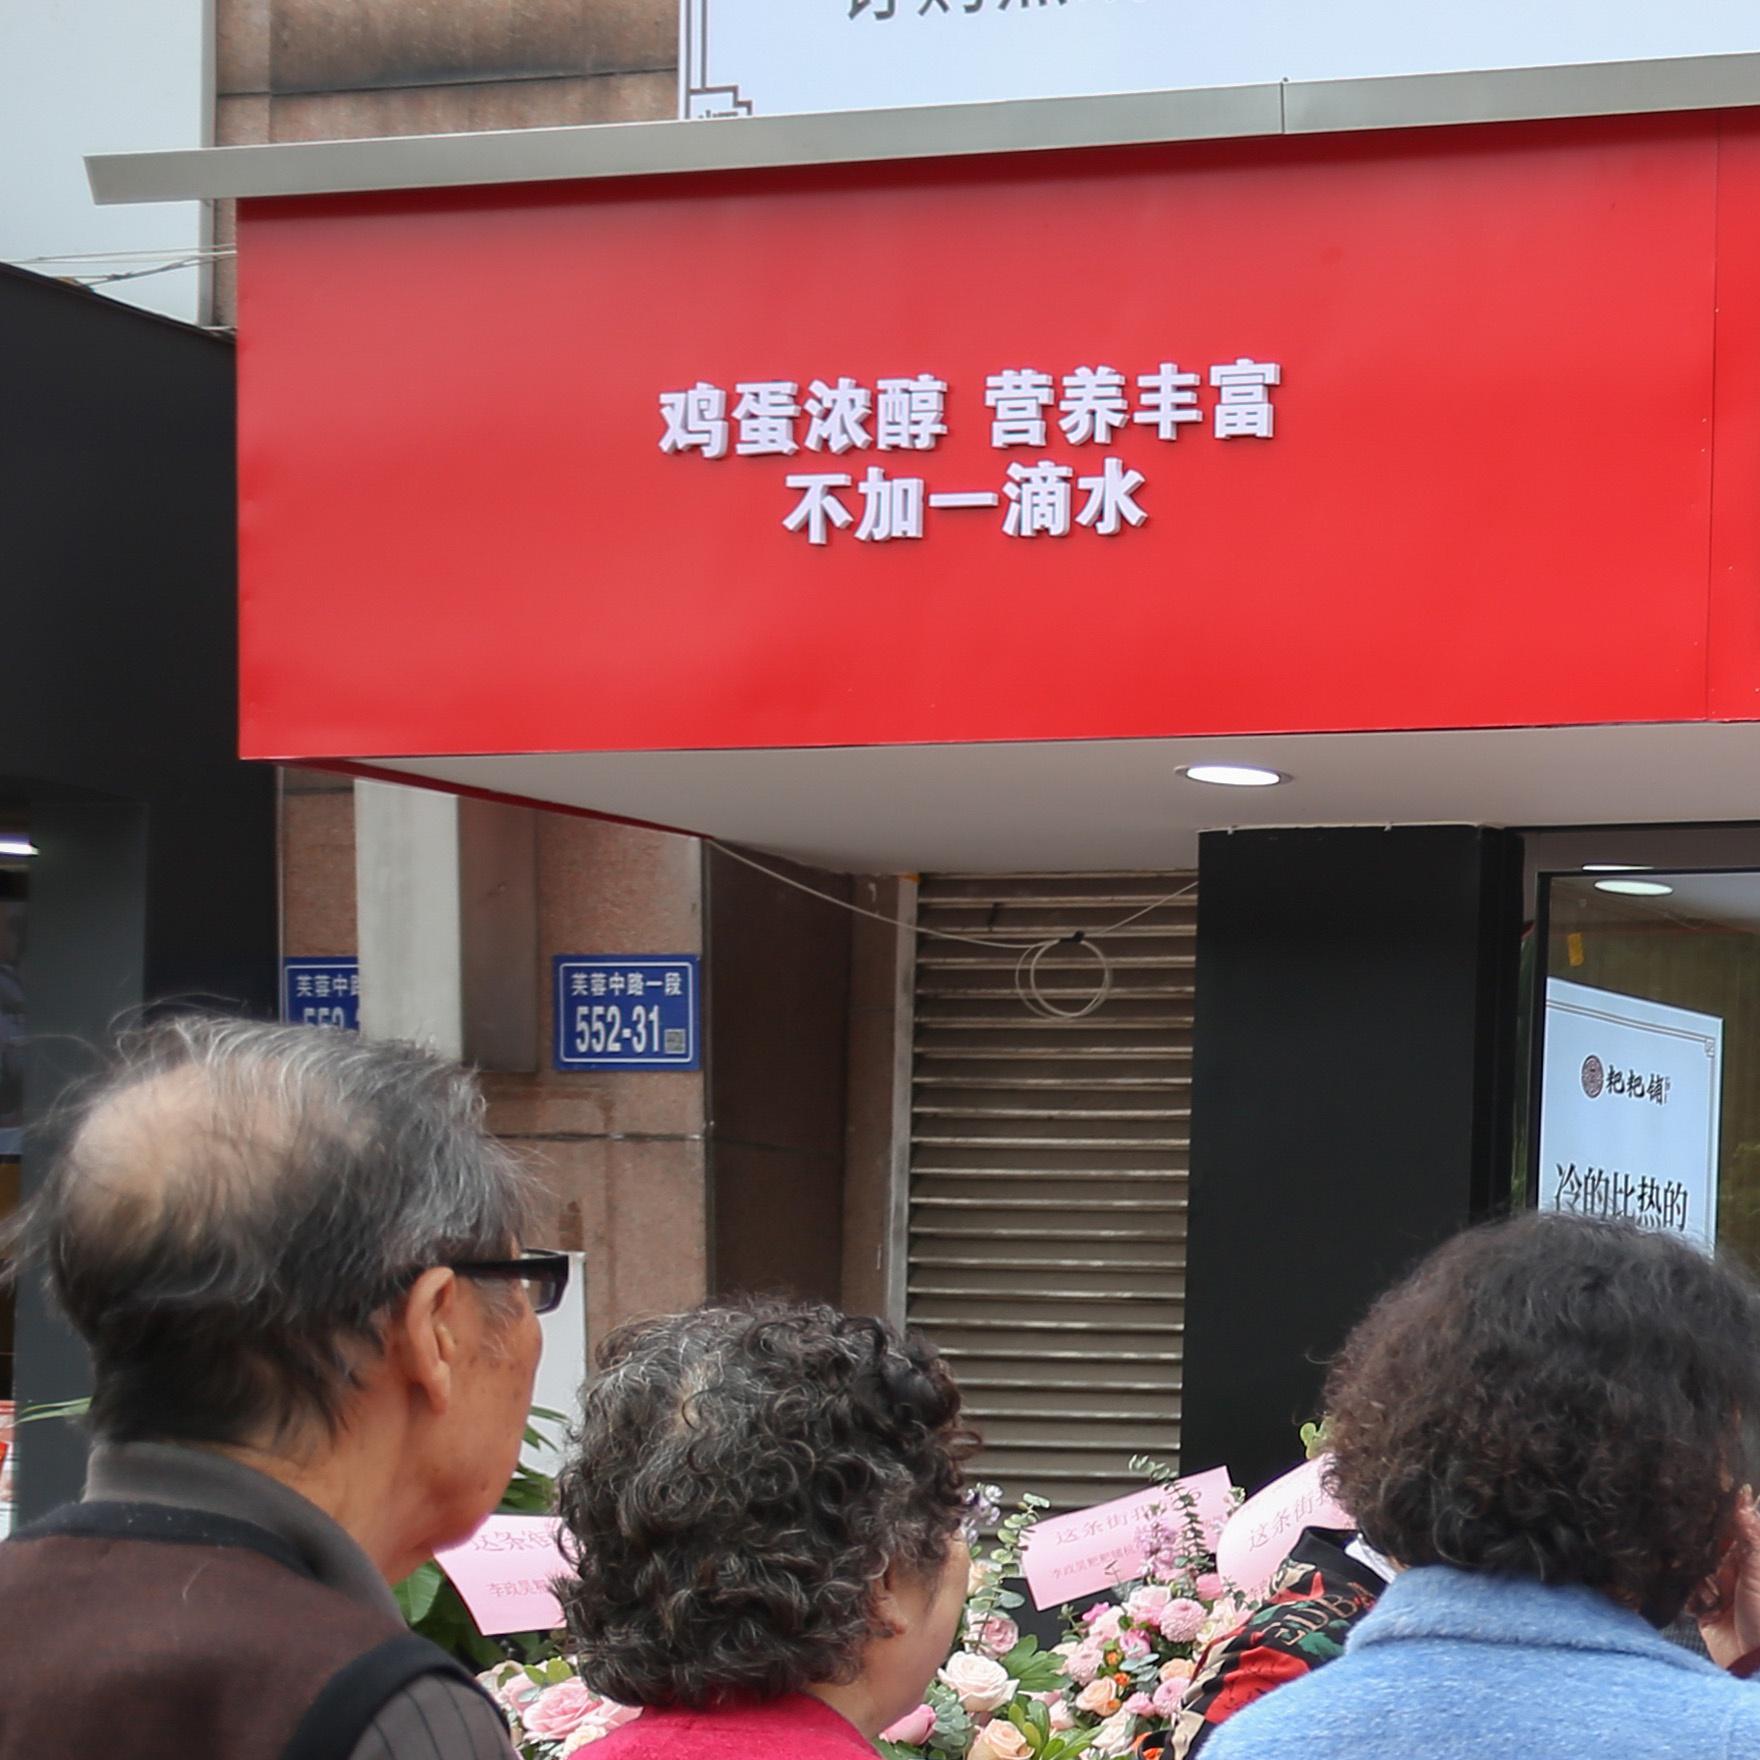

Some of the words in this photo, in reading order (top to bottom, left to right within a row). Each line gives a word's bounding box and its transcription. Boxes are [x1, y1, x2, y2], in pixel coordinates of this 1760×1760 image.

[658, 374, 949, 459] 鸡蛋浓醇
[984, 358, 1281, 449] 营养丰富
[782, 457, 1149, 546] 不加一滴水
[570, 971, 683, 997] 芙蓉中路一段
[574, 1004, 663, 1054] 552-31
[1554, 1162, 1688, 1232] 冷的比热的
